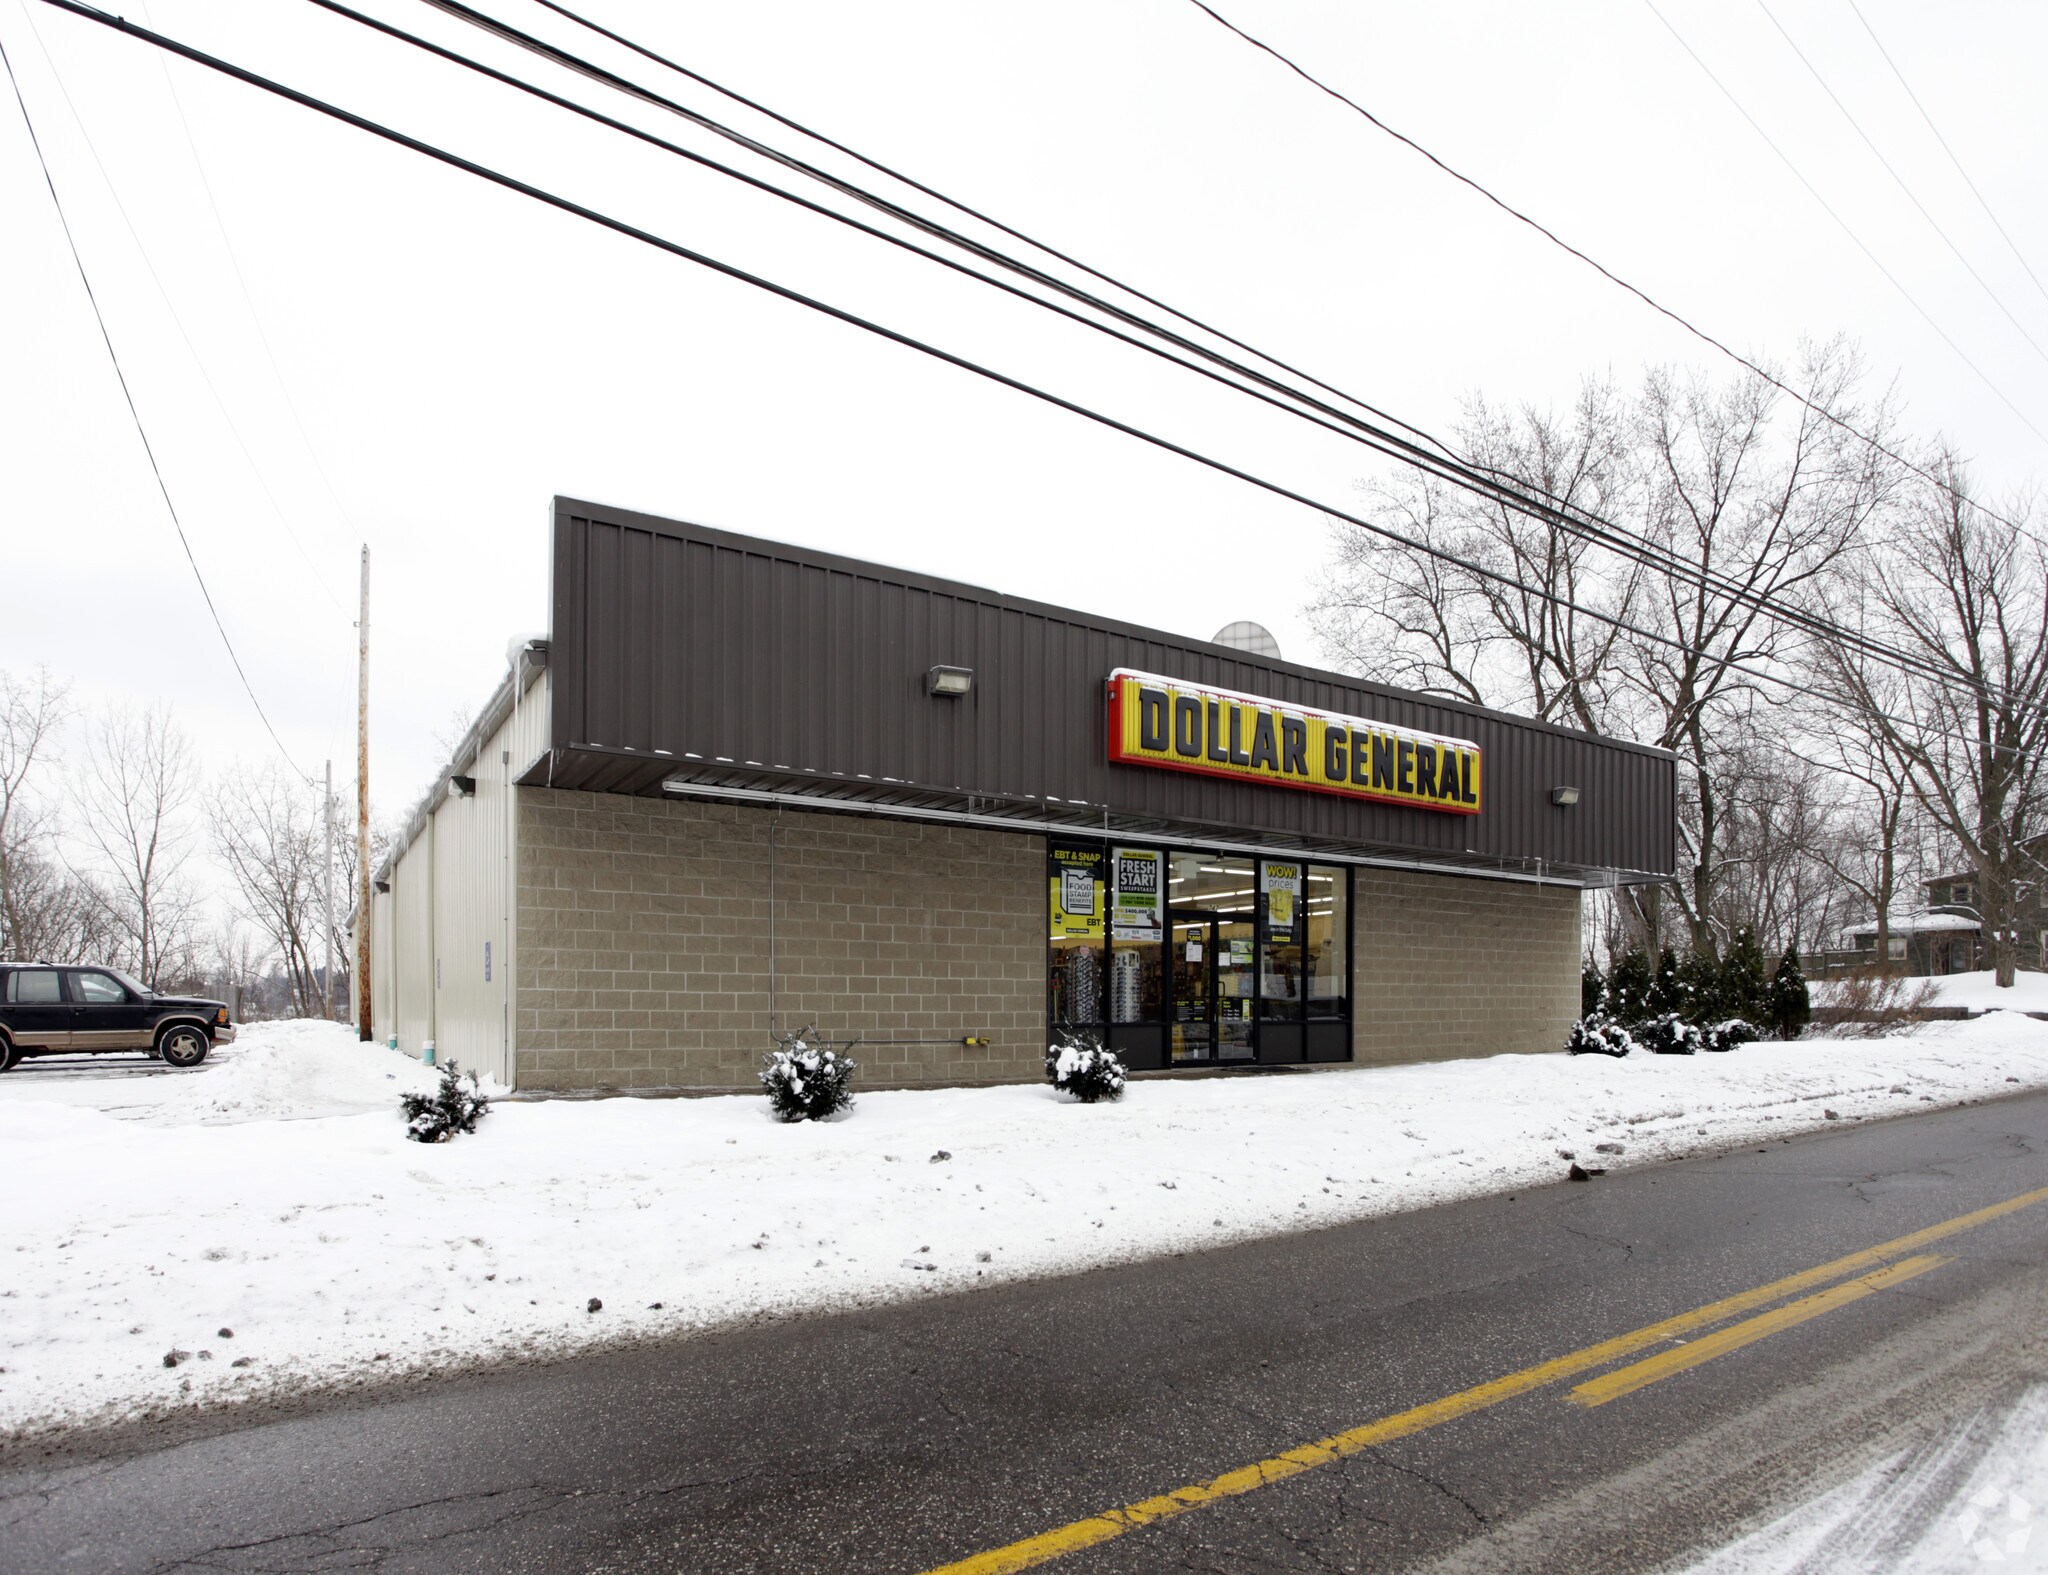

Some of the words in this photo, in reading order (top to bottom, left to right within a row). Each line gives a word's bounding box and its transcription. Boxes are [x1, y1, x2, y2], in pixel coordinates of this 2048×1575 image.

[1138, 686, 1309, 776] DOLLAR
[1325, 724, 1477, 804] GENERAL
[1054, 850, 1070, 860] EBT
[1071, 851, 1078, 860] &
[1078, 852, 1101, 862] SNAP
[1120, 859, 1156, 874] FRESH
[1266, 864, 1298, 879] WOW!
[1120, 872, 1156, 887] START
[1268, 879, 1294, 889] prices
[1069, 882, 1092, 891] FOOD
[1069, 890, 1092, 898] STAMP
[1086, 918, 1101, 926] EBT
